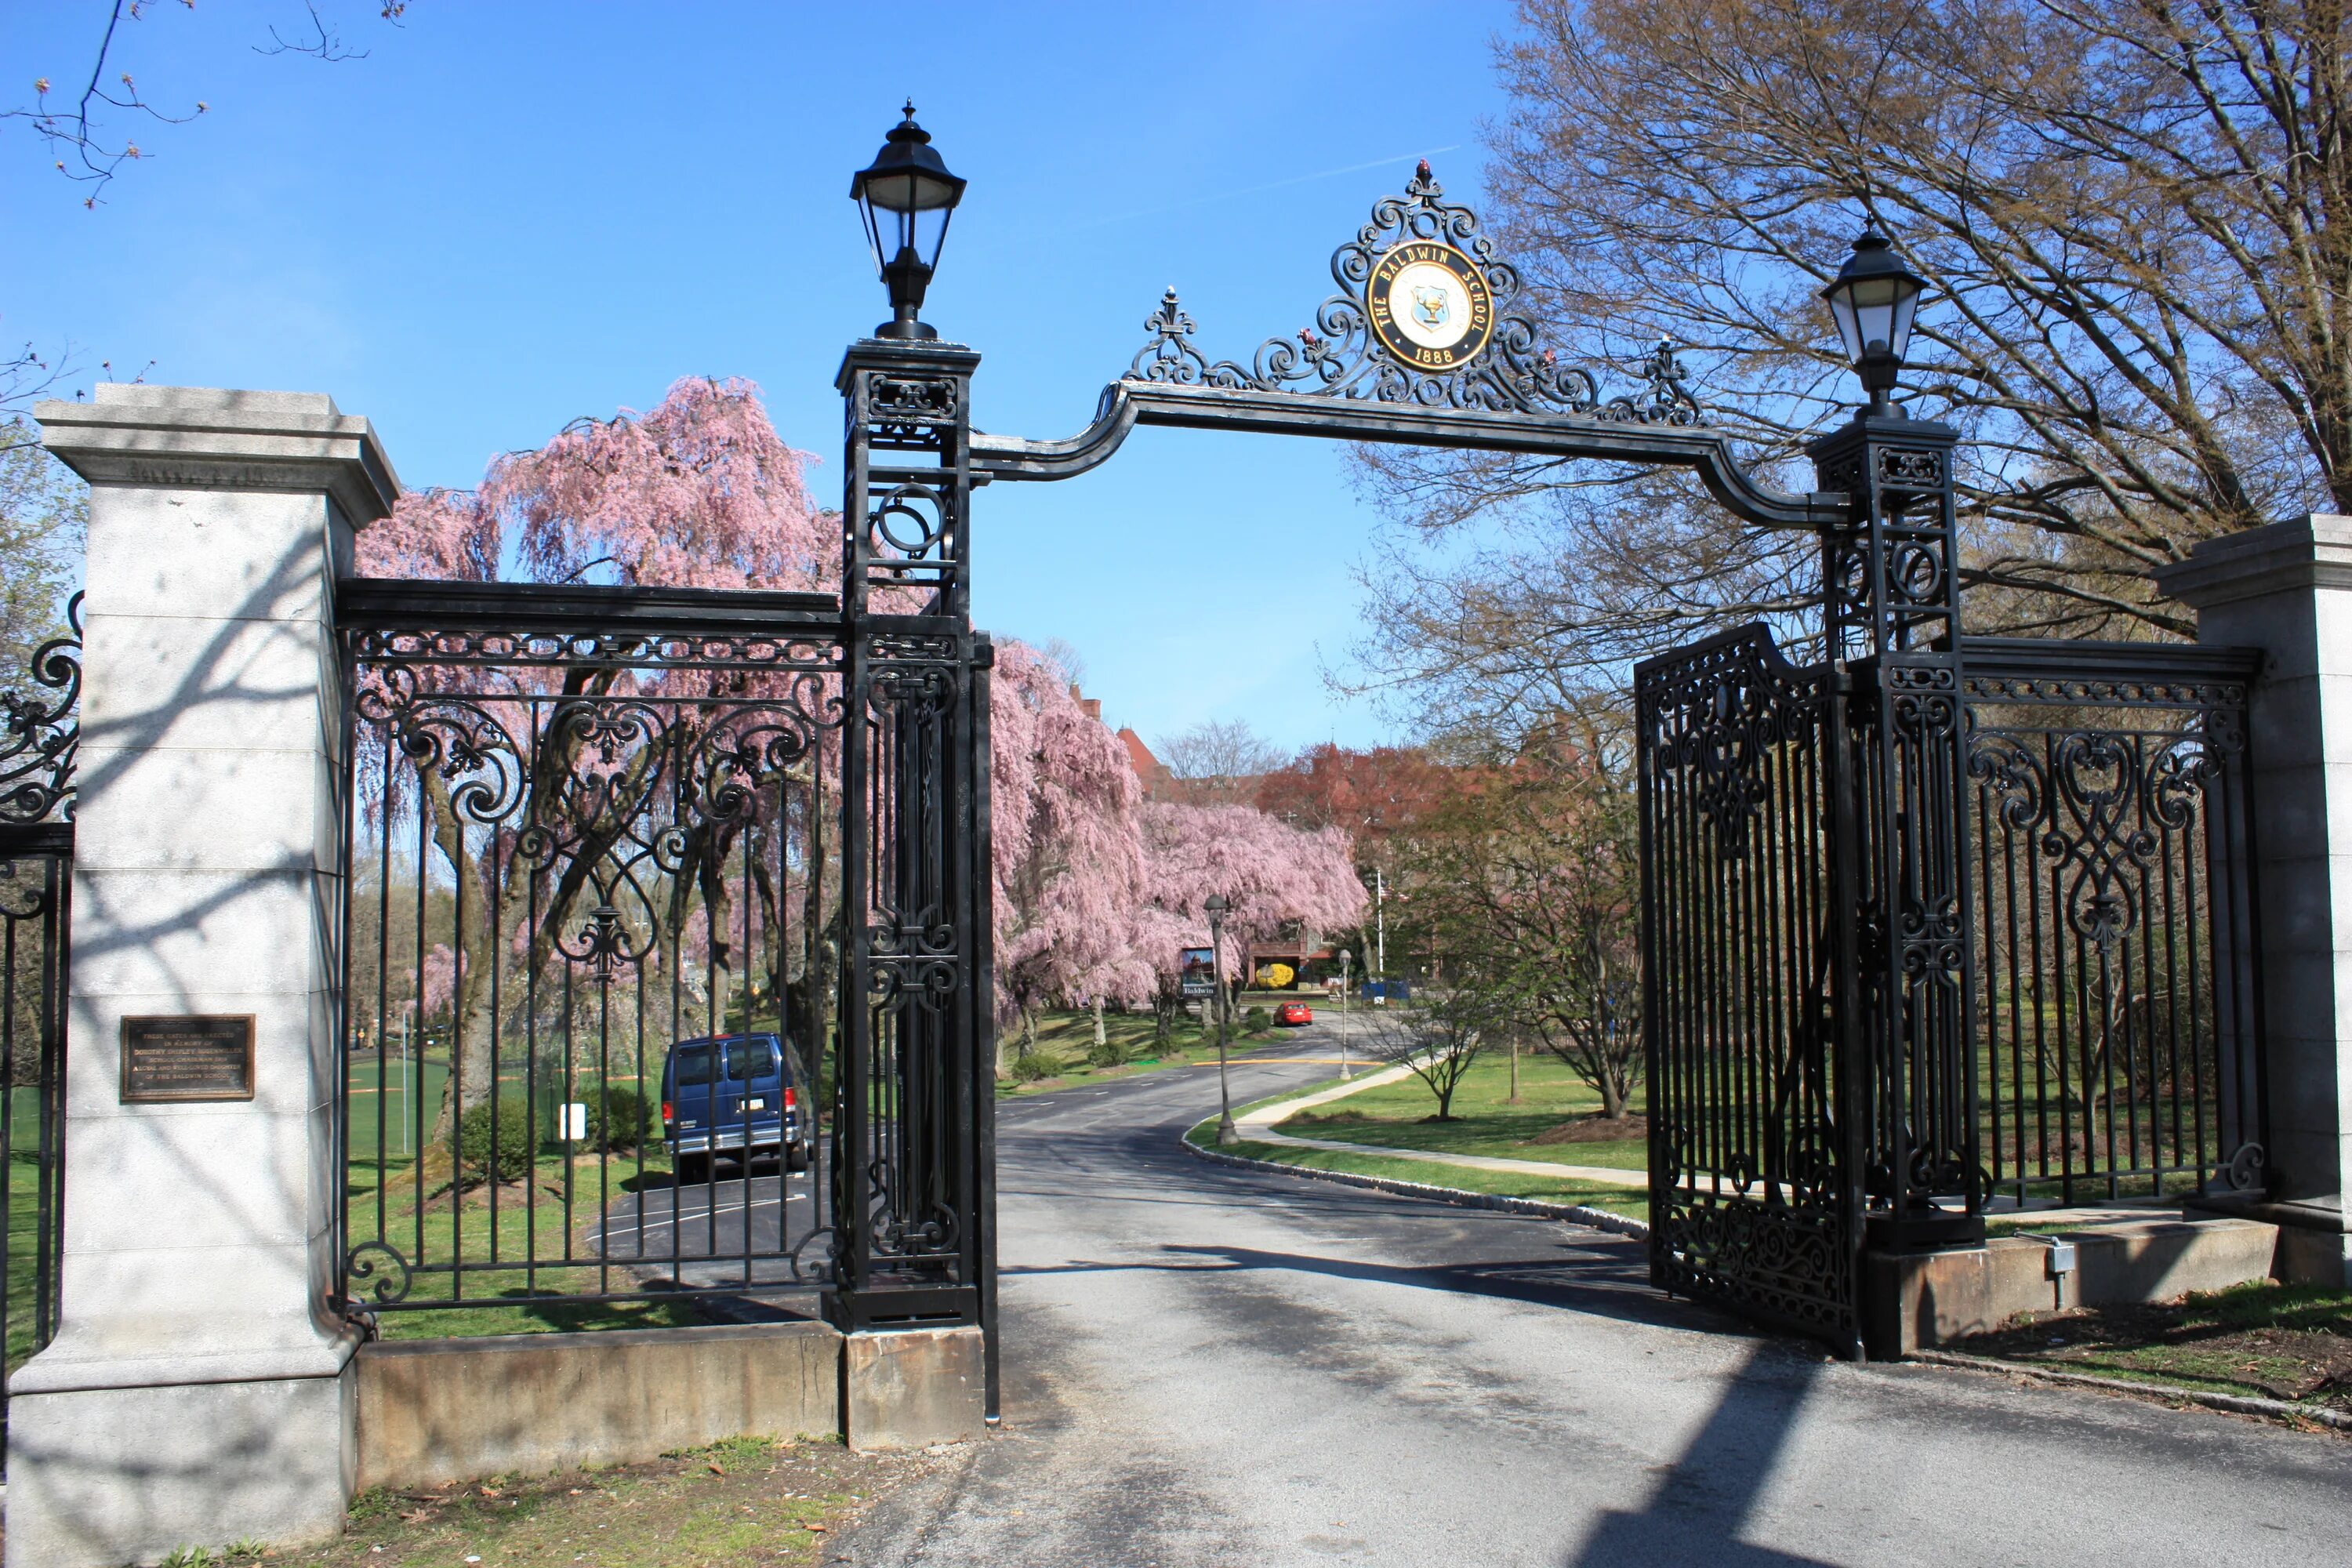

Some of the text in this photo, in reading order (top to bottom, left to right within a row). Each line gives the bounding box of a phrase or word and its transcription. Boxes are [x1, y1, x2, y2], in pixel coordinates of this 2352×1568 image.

[1374, 246, 1486, 332] THE BALDWIN SCHOOL
[1415, 347, 1453, 364] 1888
